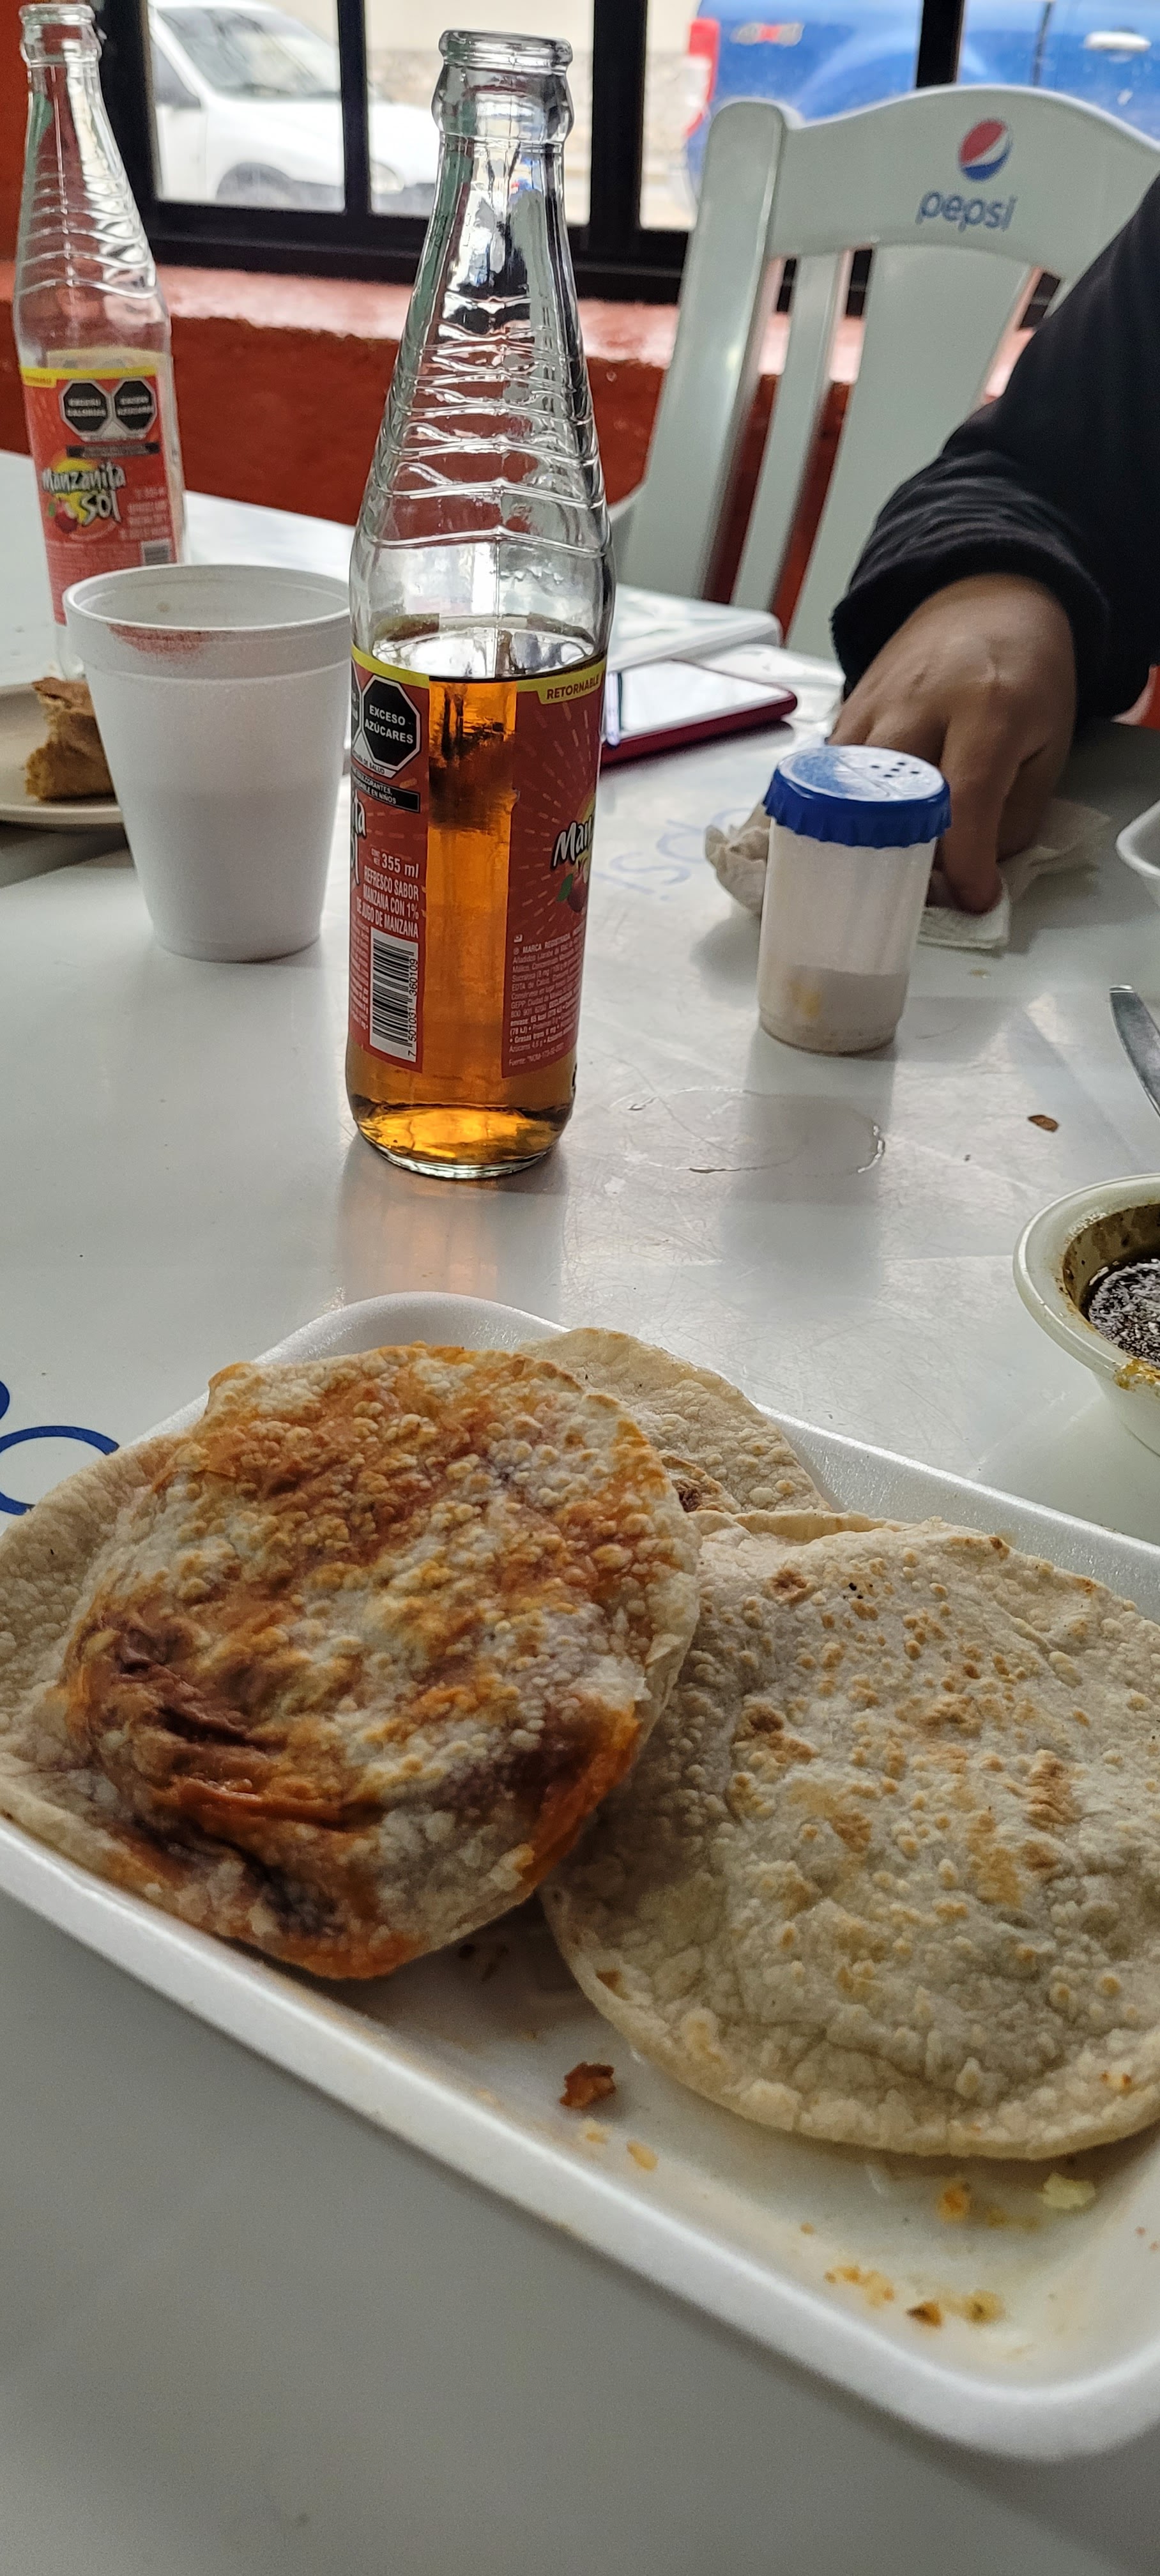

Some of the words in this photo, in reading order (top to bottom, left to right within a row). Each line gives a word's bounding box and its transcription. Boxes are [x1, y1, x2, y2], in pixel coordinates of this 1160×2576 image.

[915, 191, 1018, 232] pepsi
[547, 674, 599, 700] RETORNABLE
[365, 719, 413, 744] AZÚCARES
[369, 704, 406, 726] EXCESO
[379, 793, 396, 804] NIÑOS
[364, 865, 392, 894] REFRESCO
[394, 879, 419, 901] SABOR
[382, 853, 401, 873] 355
[404, 863, 419, 878] ml
[363, 883, 389, 912] MANZANA
[390, 897, 405, 916] CON
[406, 902, 419, 920] 1%
[362, 901, 374, 923] JUGO
[375, 909, 383, 927] DE
[384, 913, 419, 939] MANZANA
[409, 959, 418, 996] 360109
[408, 1008, 417, 1043] 501031
